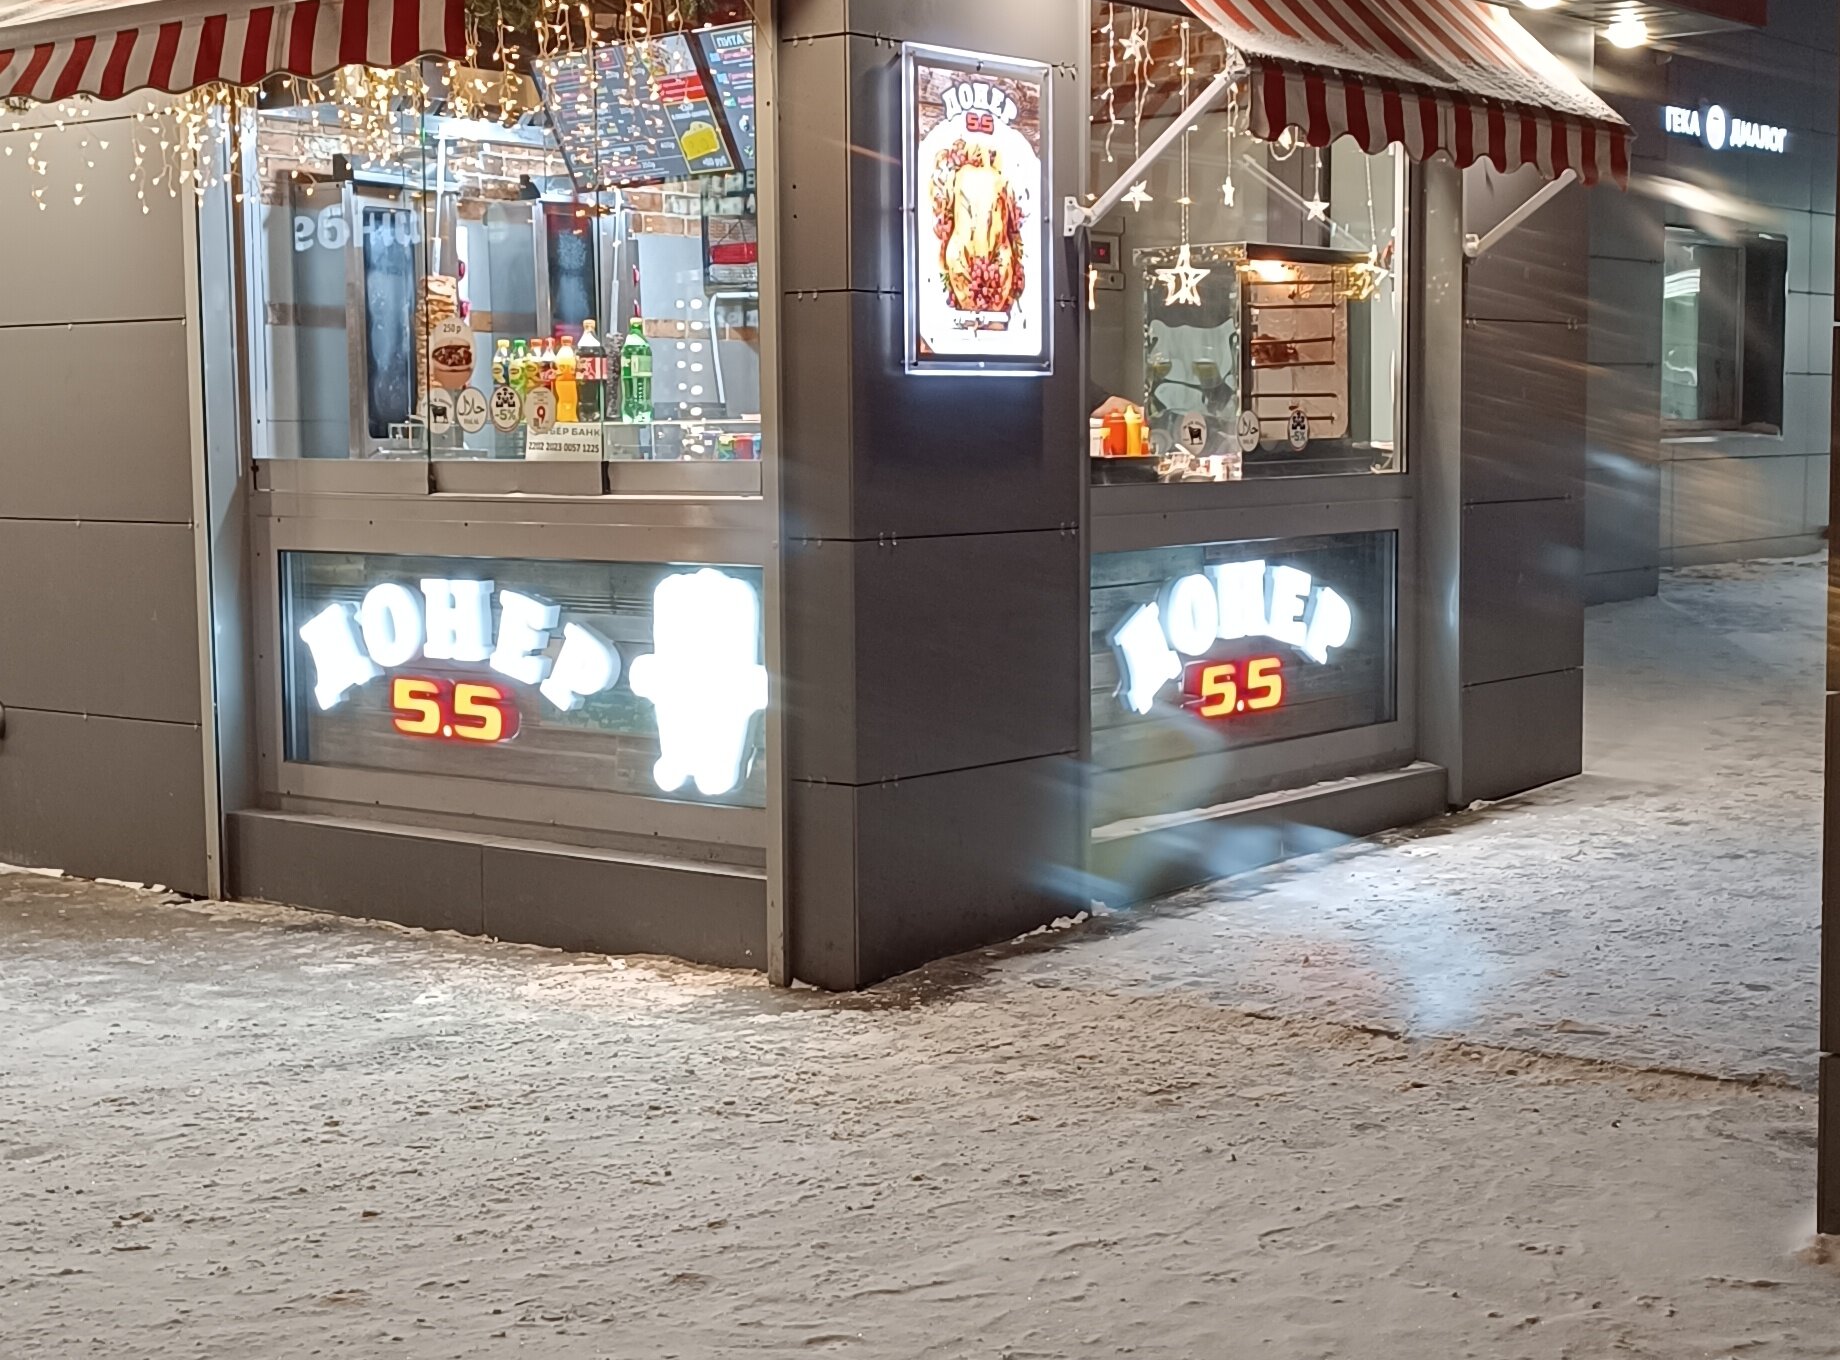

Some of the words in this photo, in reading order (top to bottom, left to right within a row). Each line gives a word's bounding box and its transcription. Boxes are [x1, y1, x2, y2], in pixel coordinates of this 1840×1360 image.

[716, 34, 745, 48] ПИТА
[1729, 118, 1788, 154] ДИАЛОГ
[543, 427, 570, 436] БЕР
[571, 428, 600, 437] БАНК
[582, 443, 600, 453] 1225
[300, 577, 622, 711] ДОНЕР
[1200, 656, 1283, 718] 5.5
[392, 677, 504, 742] 5.5
